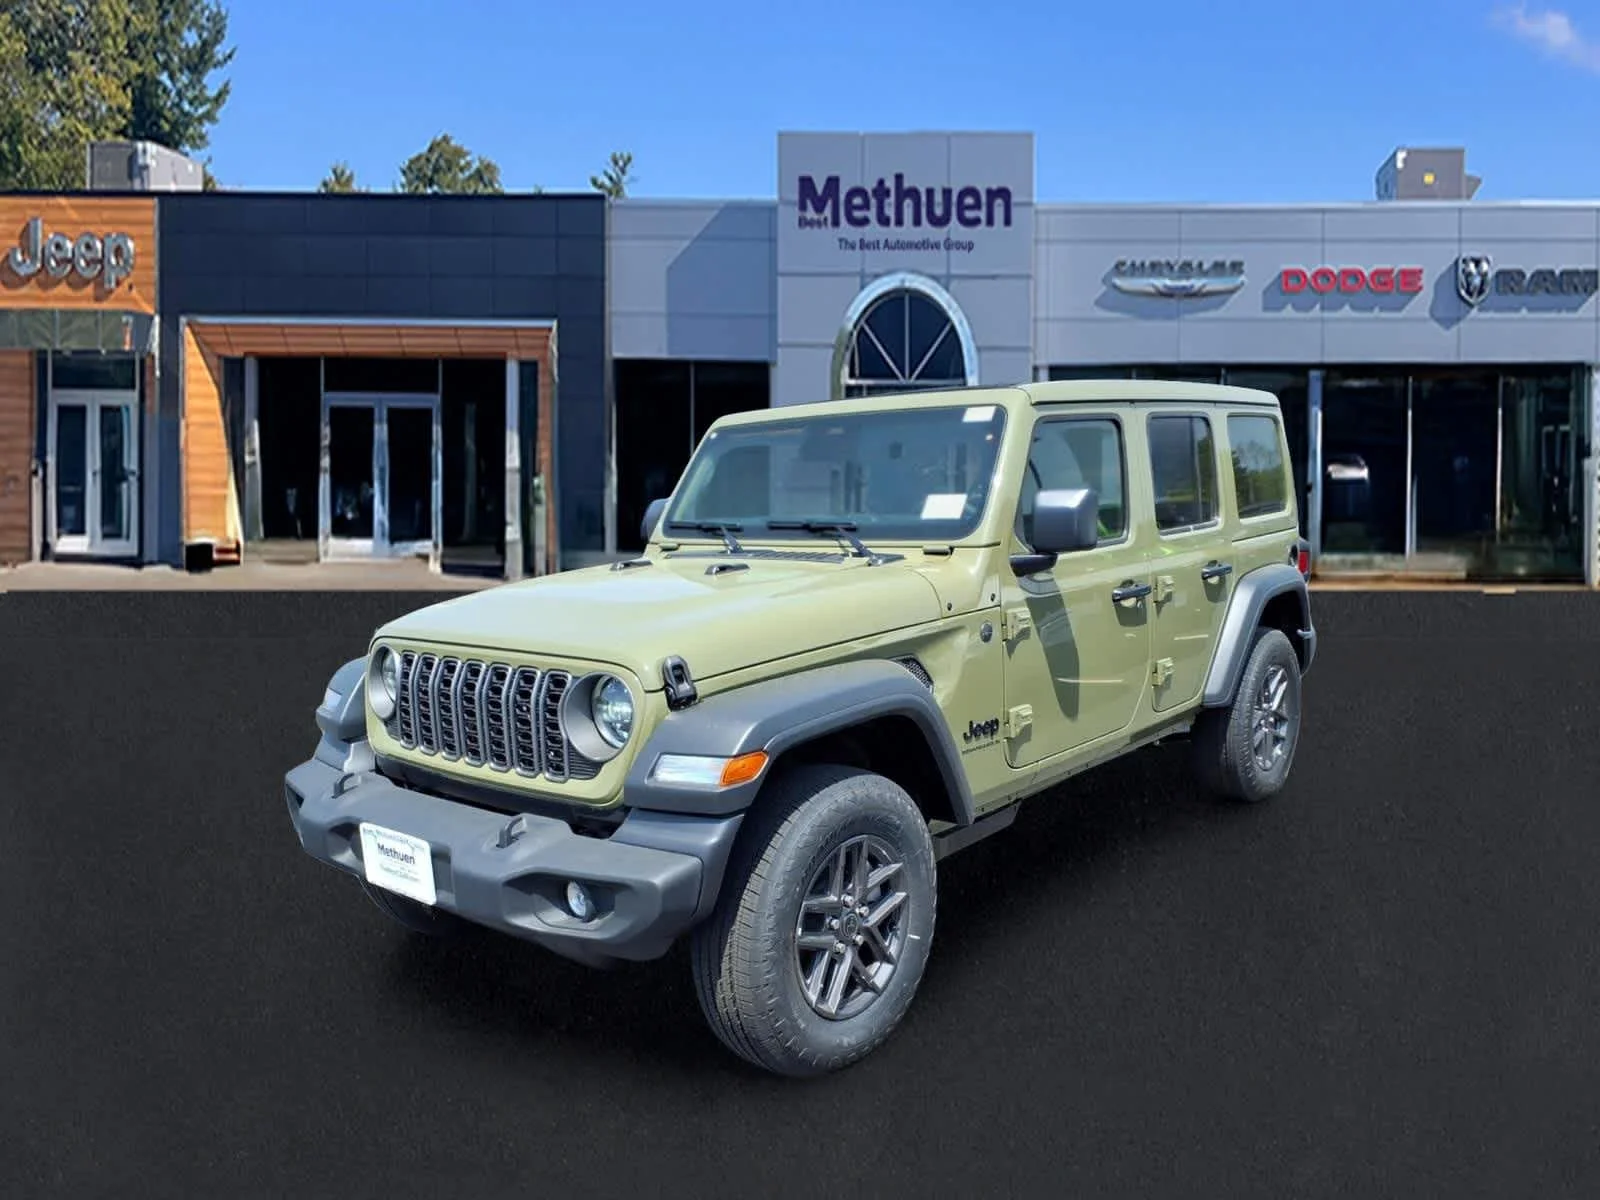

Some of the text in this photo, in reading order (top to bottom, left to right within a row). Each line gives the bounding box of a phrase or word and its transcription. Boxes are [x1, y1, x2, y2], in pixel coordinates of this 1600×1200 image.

[798, 172, 1011, 227] Methuen
[798, 215, 828, 228] Best
[8, 216, 135, 289] Jeep
[838, 238, 974, 253] The Best Automotive Group
[1114, 259, 1244, 278] CHRYSLER
[1282, 268, 1423, 293] DODGE
[1495, 268, 1599, 295] RAM
[963, 717, 999, 743] Jeep
[377, 843, 415, 865] Methuen
